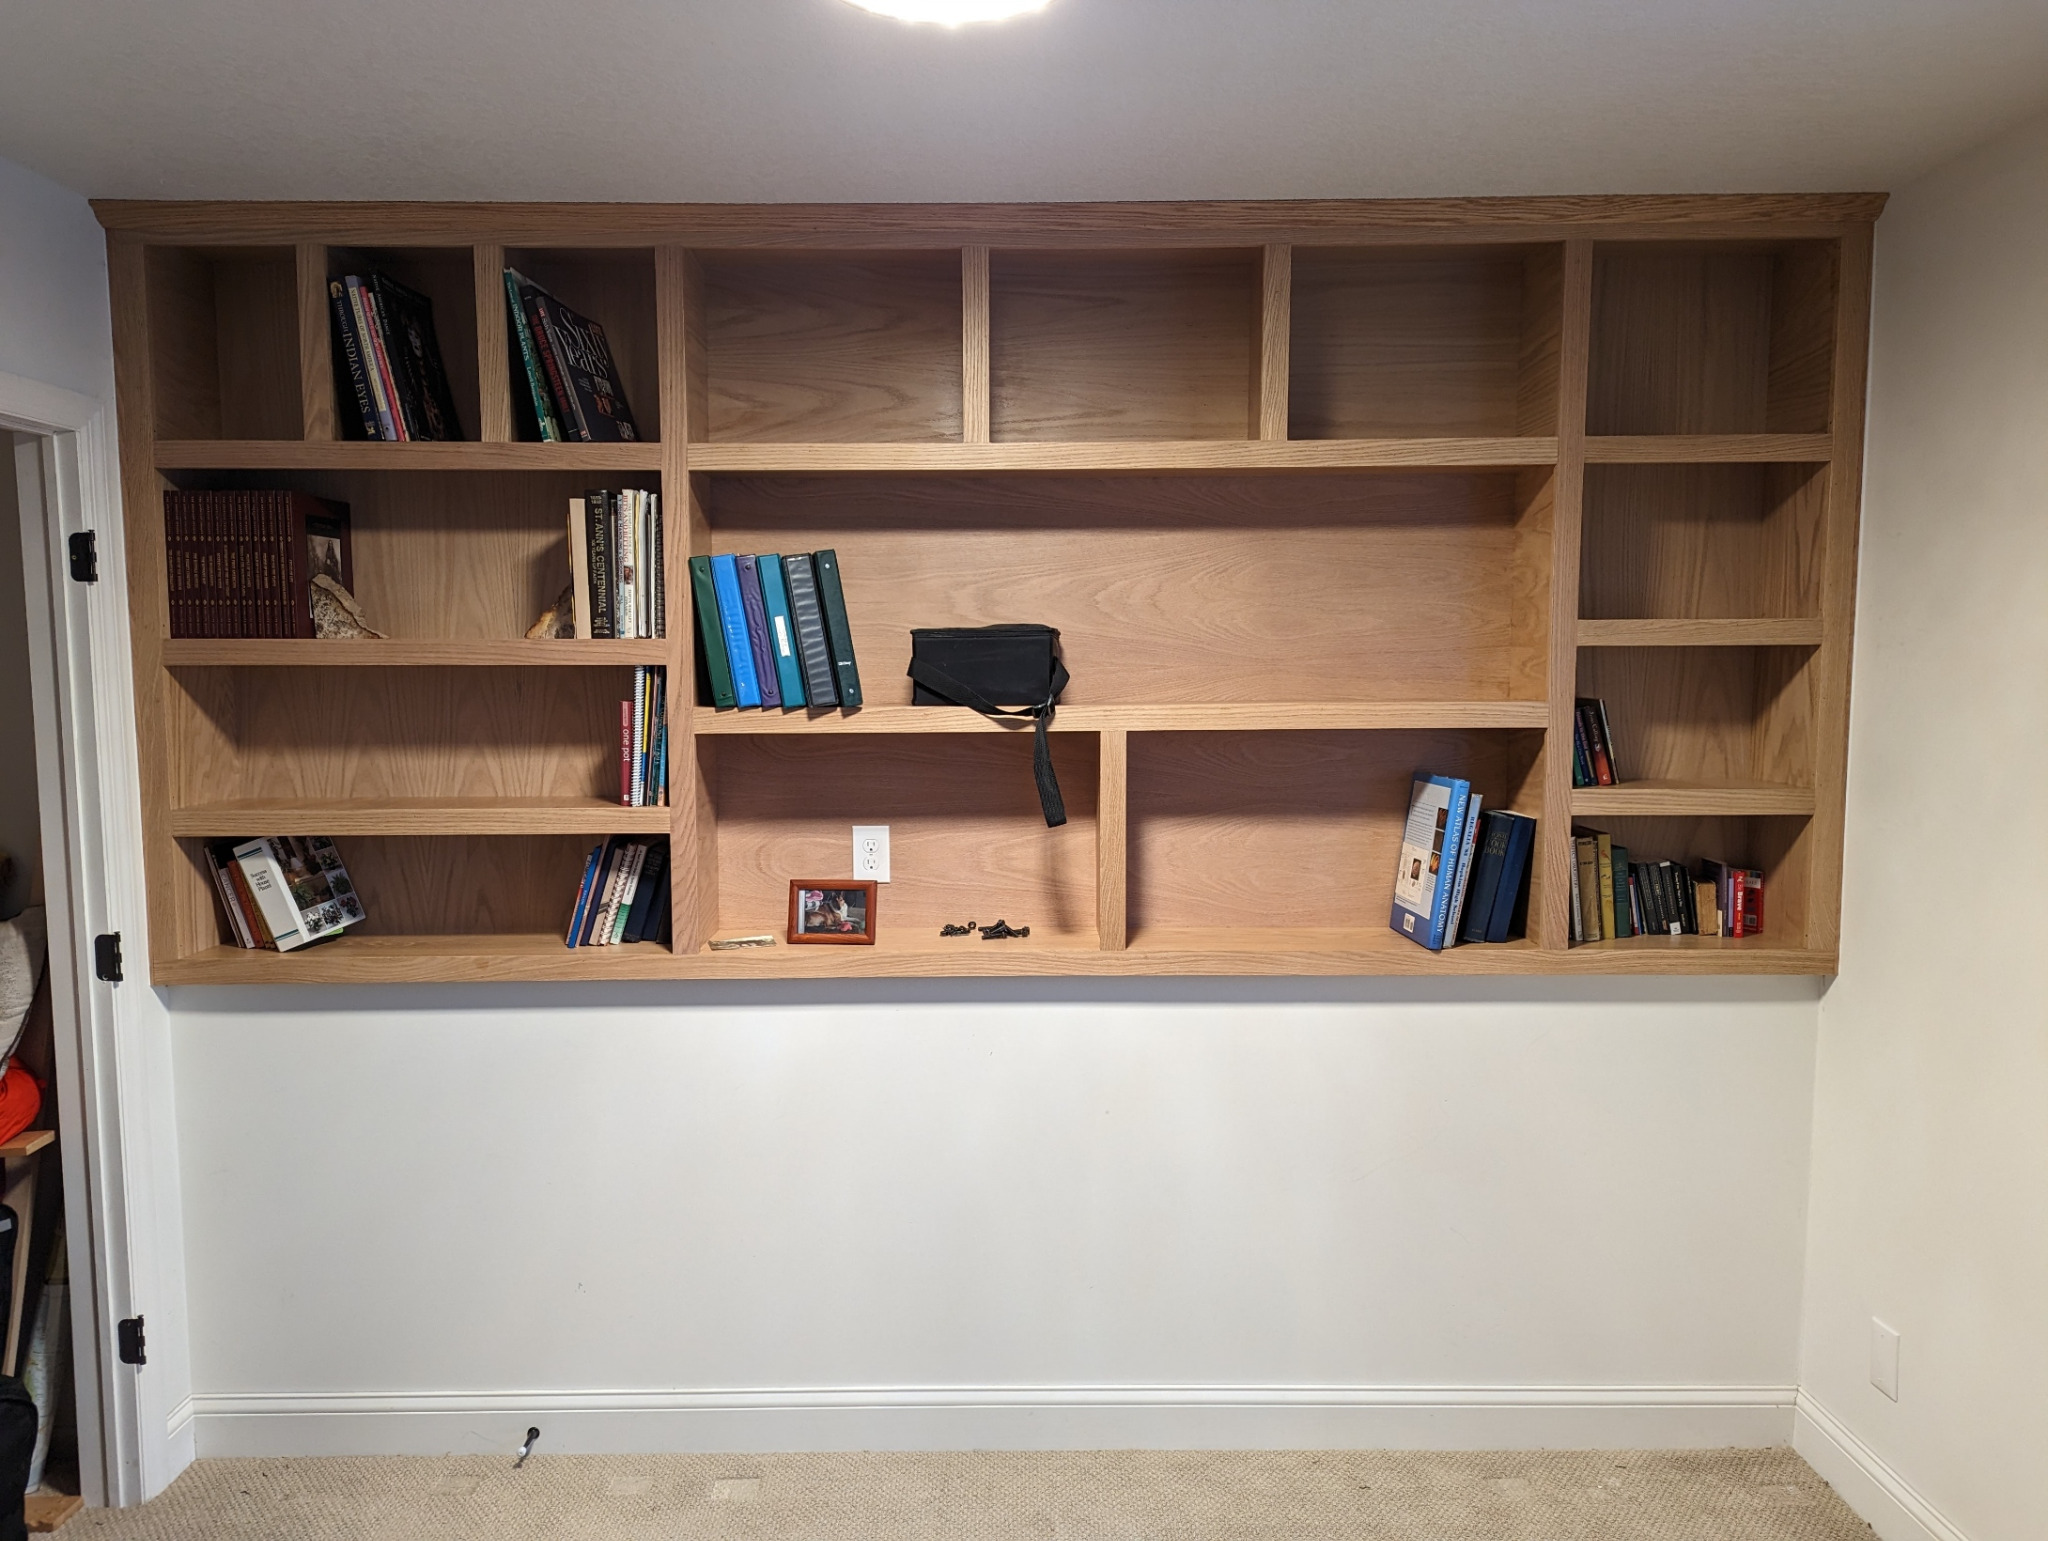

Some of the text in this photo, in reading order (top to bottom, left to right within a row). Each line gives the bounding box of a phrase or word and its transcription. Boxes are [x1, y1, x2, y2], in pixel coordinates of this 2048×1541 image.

[336, 300, 372, 414] THROUGH INDIAN EYES
[512, 303, 523, 331] INDOOR
[518, 332, 530, 360] PLANTS
[534, 325, 548, 349] BRUCE
[542, 349, 565, 397] SPRINGSTEEN
[552, 326, 608, 379] Years
[560, 308, 610, 368] Sixty
[594, 508, 607, 614] ST. ANN'S CENTENNIAL
[621, 748, 630, 762] pot
[1436, 794, 1466, 933] NEW ATLAS OF HUMAN ANATOMY
